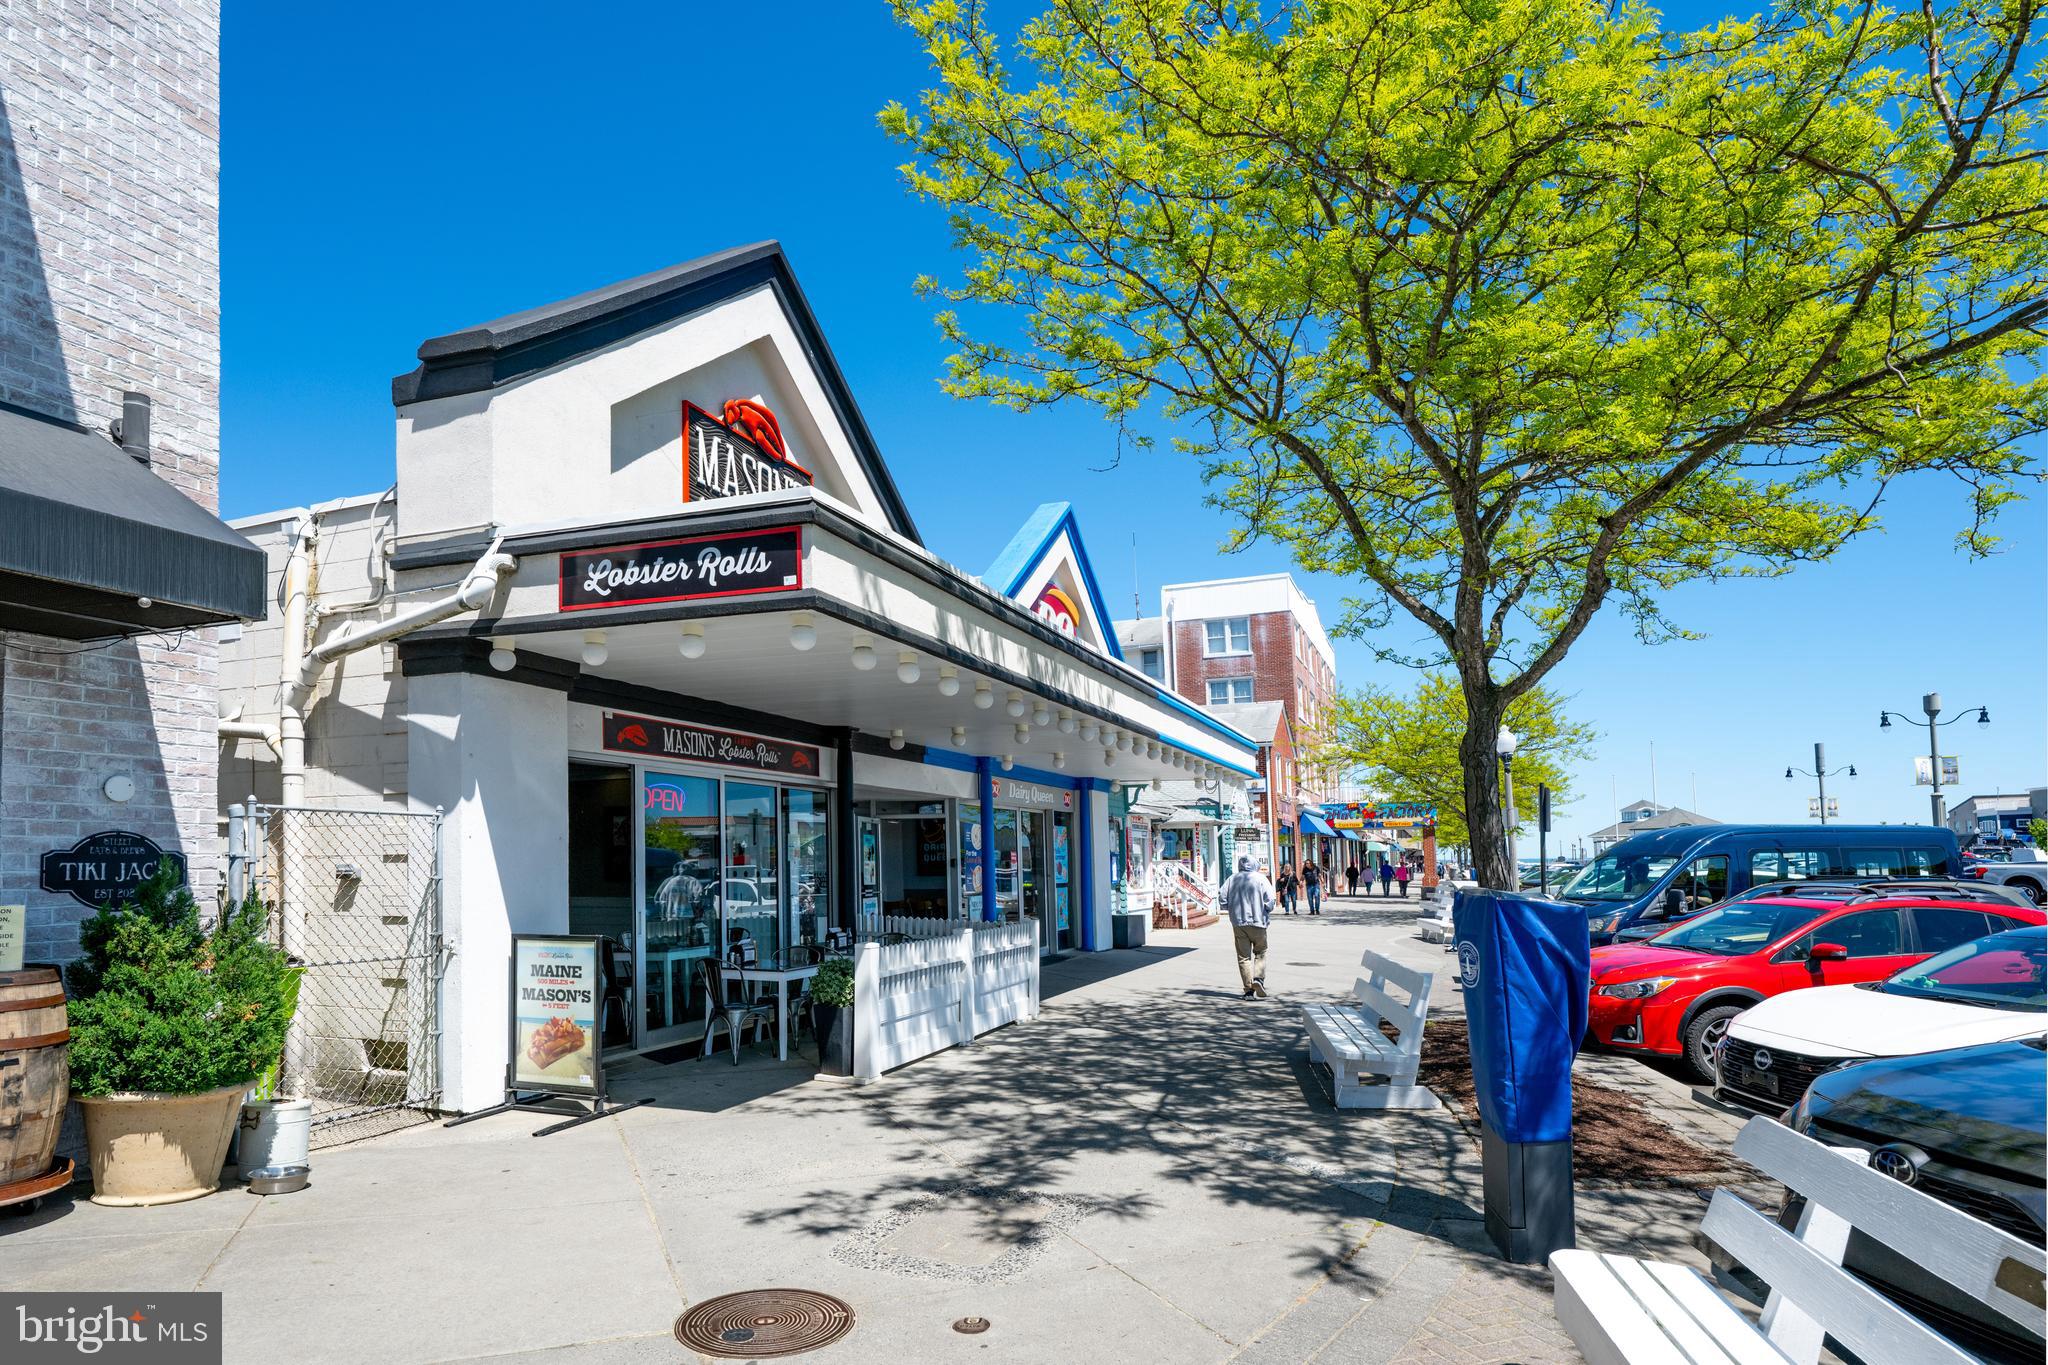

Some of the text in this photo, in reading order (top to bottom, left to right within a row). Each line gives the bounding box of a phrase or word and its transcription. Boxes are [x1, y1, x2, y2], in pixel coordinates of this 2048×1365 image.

[584, 547, 771, 596] Lobster Rolls
[663, 727, 715, 758] MASON'S
[718, 737, 755, 760] Lobster
[643, 787, 683, 812] OPEN
[1009, 783, 1030, 803] Dairy
[1031, 786, 1054, 803] Queen
[60, 862, 106, 880] TIKI
[94, 889, 112, 899] EST
[531, 964, 582, 978] MAINE
[522, 988, 591, 1003] MASON'S
